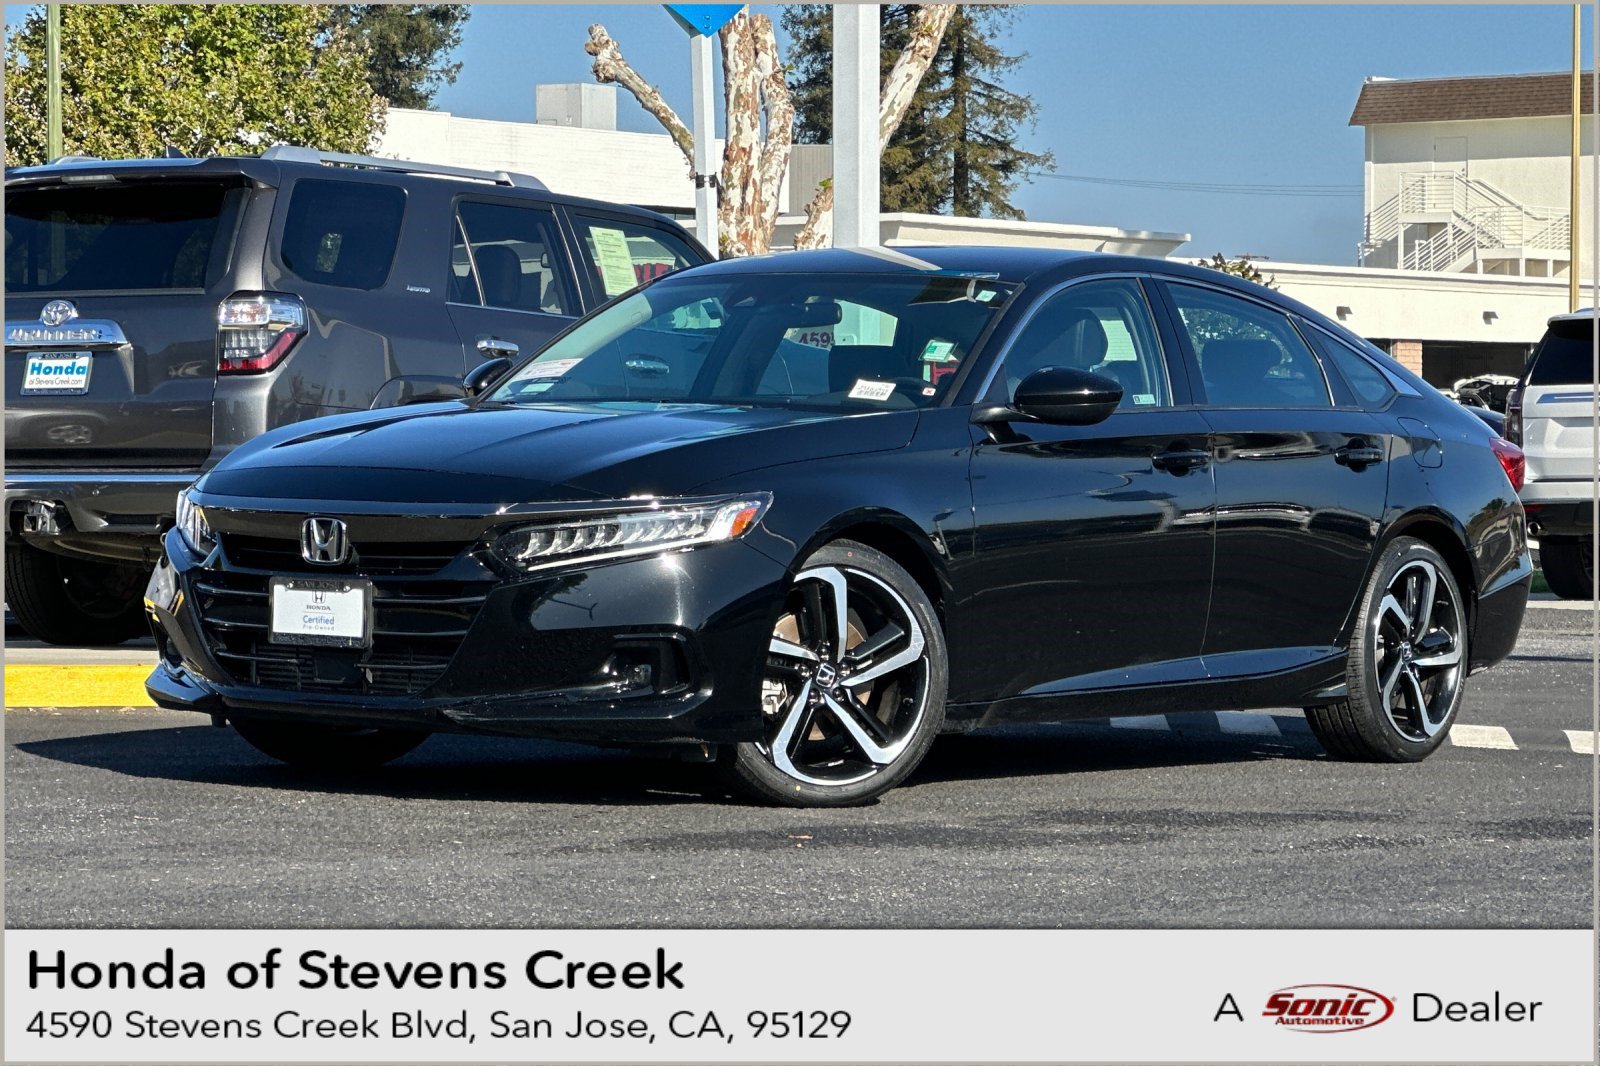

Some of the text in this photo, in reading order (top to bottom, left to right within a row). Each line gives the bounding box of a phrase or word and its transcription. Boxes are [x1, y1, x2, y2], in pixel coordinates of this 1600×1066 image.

[799, 331, 835, 348] 459
[30, 361, 87, 375] Honda
[302, 615, 335, 625] Certified
